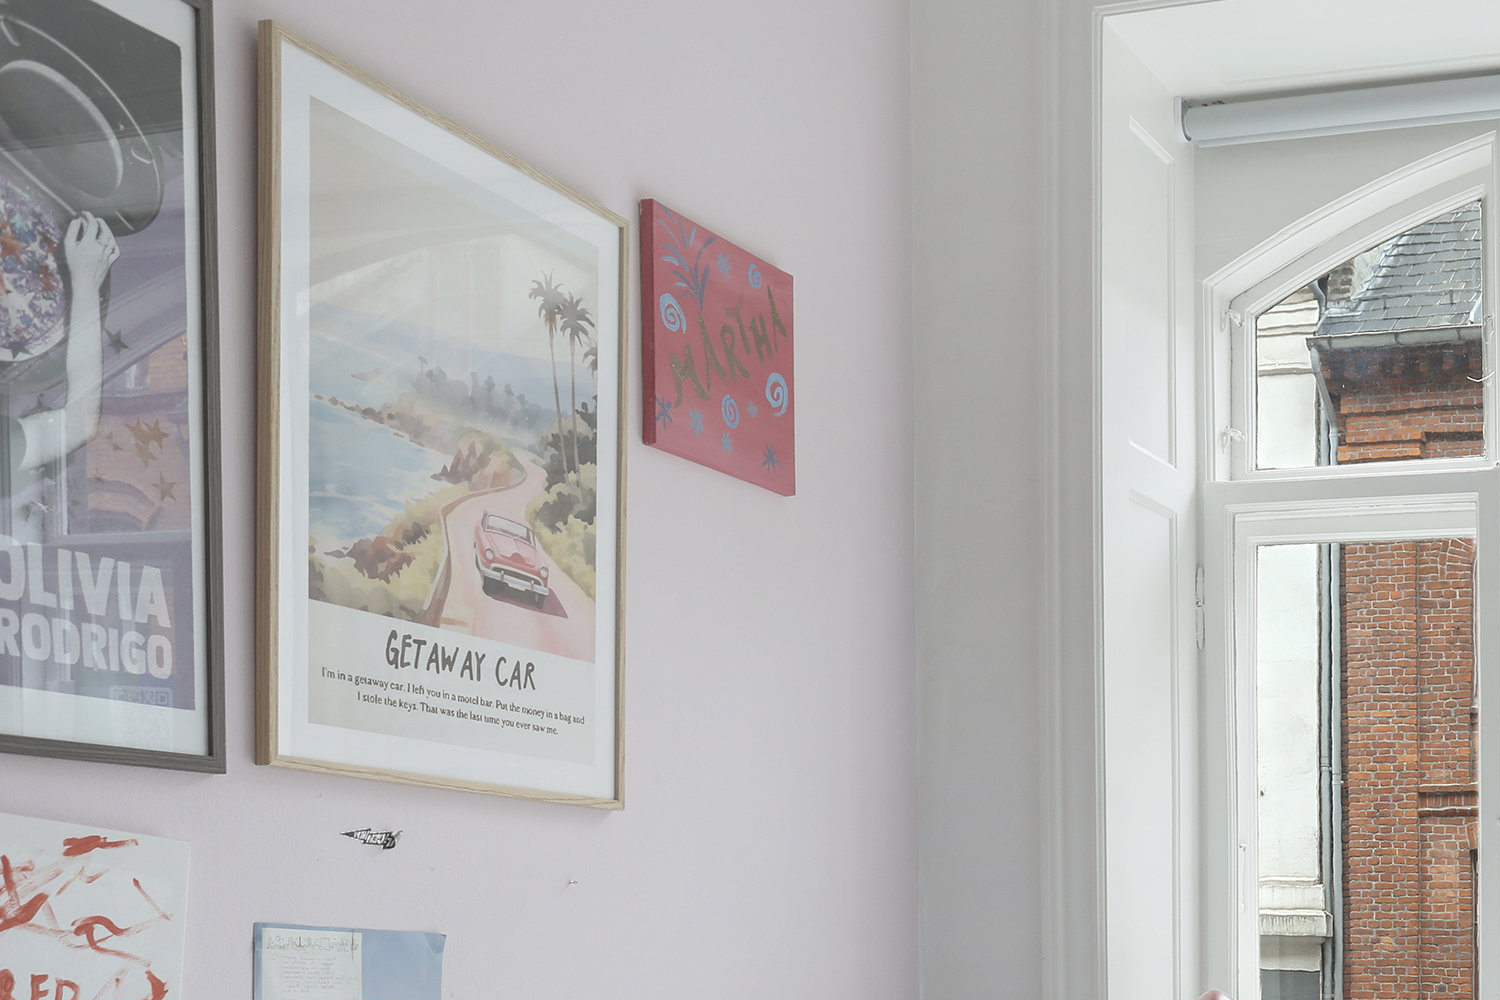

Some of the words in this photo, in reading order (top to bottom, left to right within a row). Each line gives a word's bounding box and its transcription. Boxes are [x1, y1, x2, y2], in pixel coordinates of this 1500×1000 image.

[670, 284, 787, 407] MARTHA
[0, 534, 171, 628] OLIVIA
[0, 607, 172, 679] RODRIGO
[385, 629, 486, 682] GETAWAY
[495, 656, 536, 690] CAR
[321, 666, 335, 679] I'm
[337, 669, 346, 680] in
[347, 674, 353, 682] a
[354, 674, 389, 691] getaway
[390, 681, 406, 692] car.
[412, 683, 425, 695] left
[426, 687, 441, 699] you
[442, 689, 450, 700] in
[457, 695, 479, 706] motel
[480, 696, 494, 709] bar.
[495, 699, 508, 711] Put
[509, 702, 521, 713] the
[521, 706, 545, 720] money
[546, 709, 553, 719] in
[559, 711, 572, 725] bag
[572, 715, 585, 726] and
[362, 693, 383, 705] stole
[384, 696, 397, 708] the
[399, 698, 418, 712] keys.
[419, 701, 438, 714] That
[440, 708, 455, 718] was
[456, 709, 469, 720] the
[469, 710, 483, 722] last
[484, 714, 500, 725] time
[501, 718, 515, 728] you
[516, 720, 531, 729] ever
[532, 723, 545, 732] saw
[546, 726, 558, 735] me.
